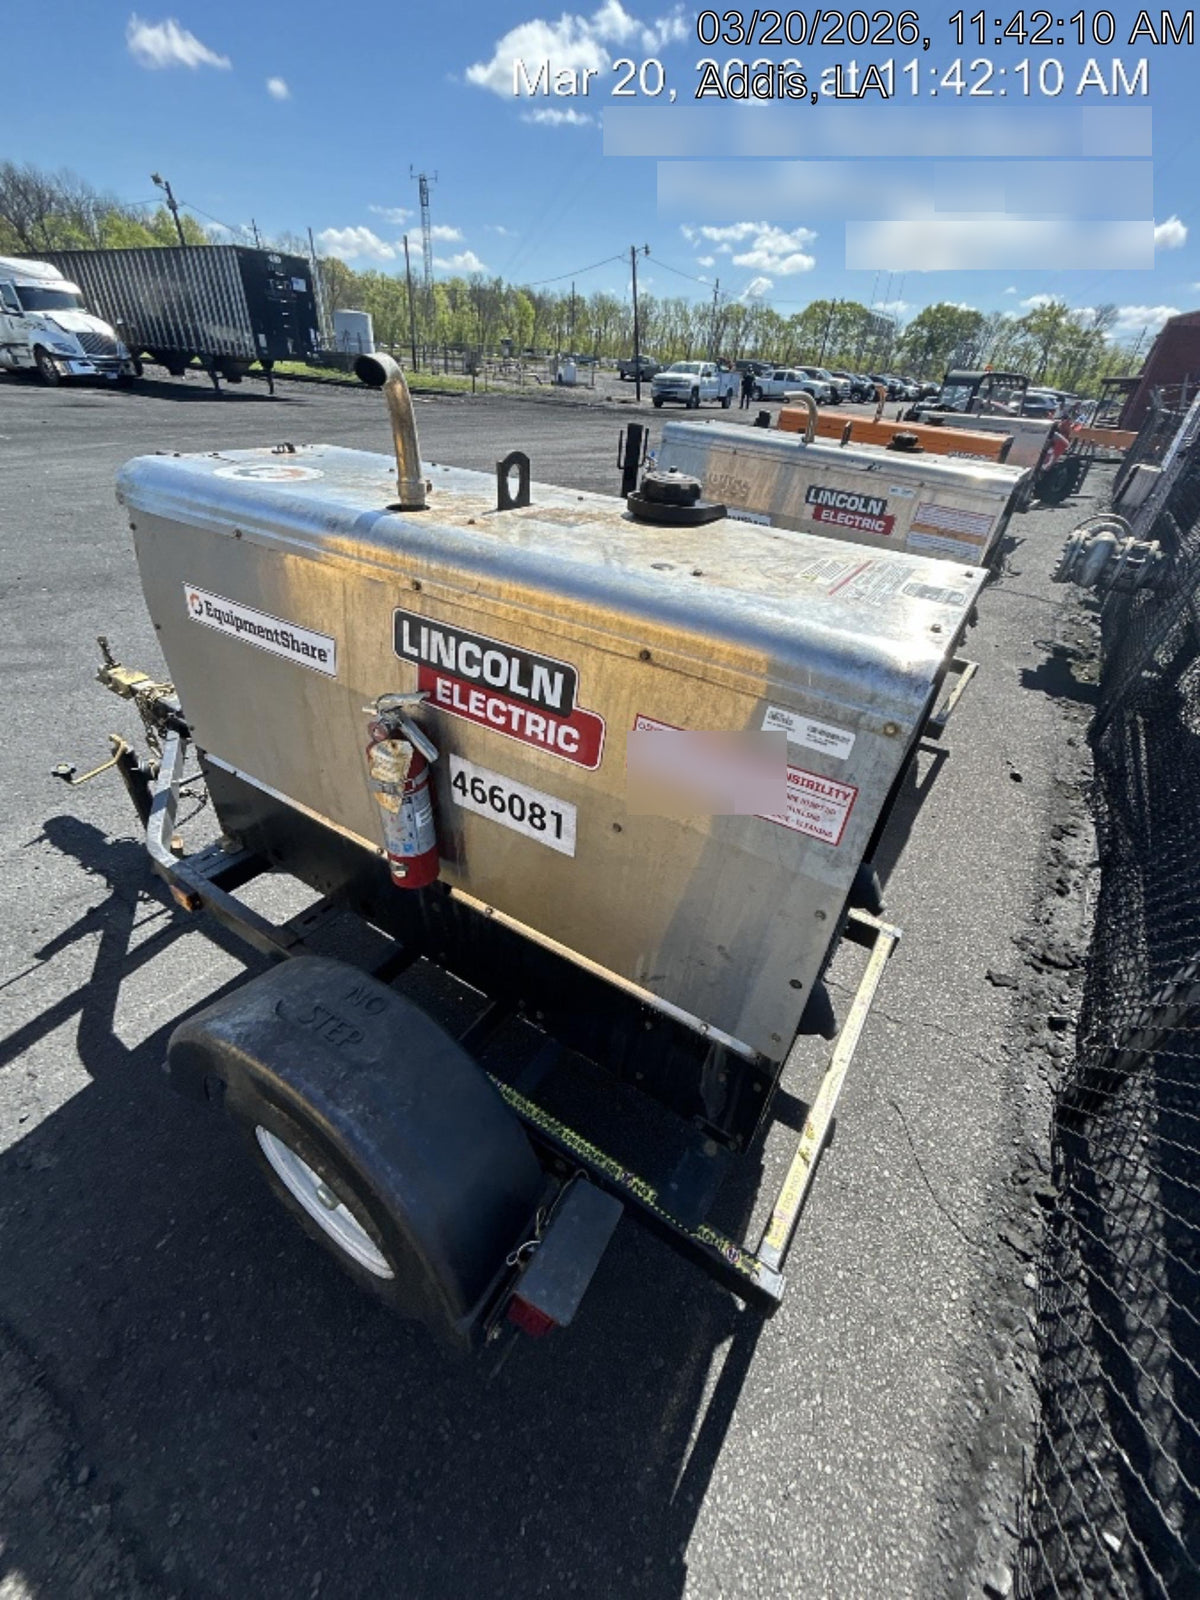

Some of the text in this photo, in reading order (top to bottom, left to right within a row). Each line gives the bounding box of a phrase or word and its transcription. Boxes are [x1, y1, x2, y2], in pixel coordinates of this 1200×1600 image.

[808, 487, 883, 516] LINCOLN
[820, 509, 886, 532] ELECTRIC
[204, 600, 328, 662] EquipmentShare
[402, 619, 565, 708] LINCOLN
[436, 676, 581, 753] ELECTRIC
[452, 770, 563, 840] 466081
[297, 1005, 365, 1047] STEP
[345, 986, 390, 1015] NO
